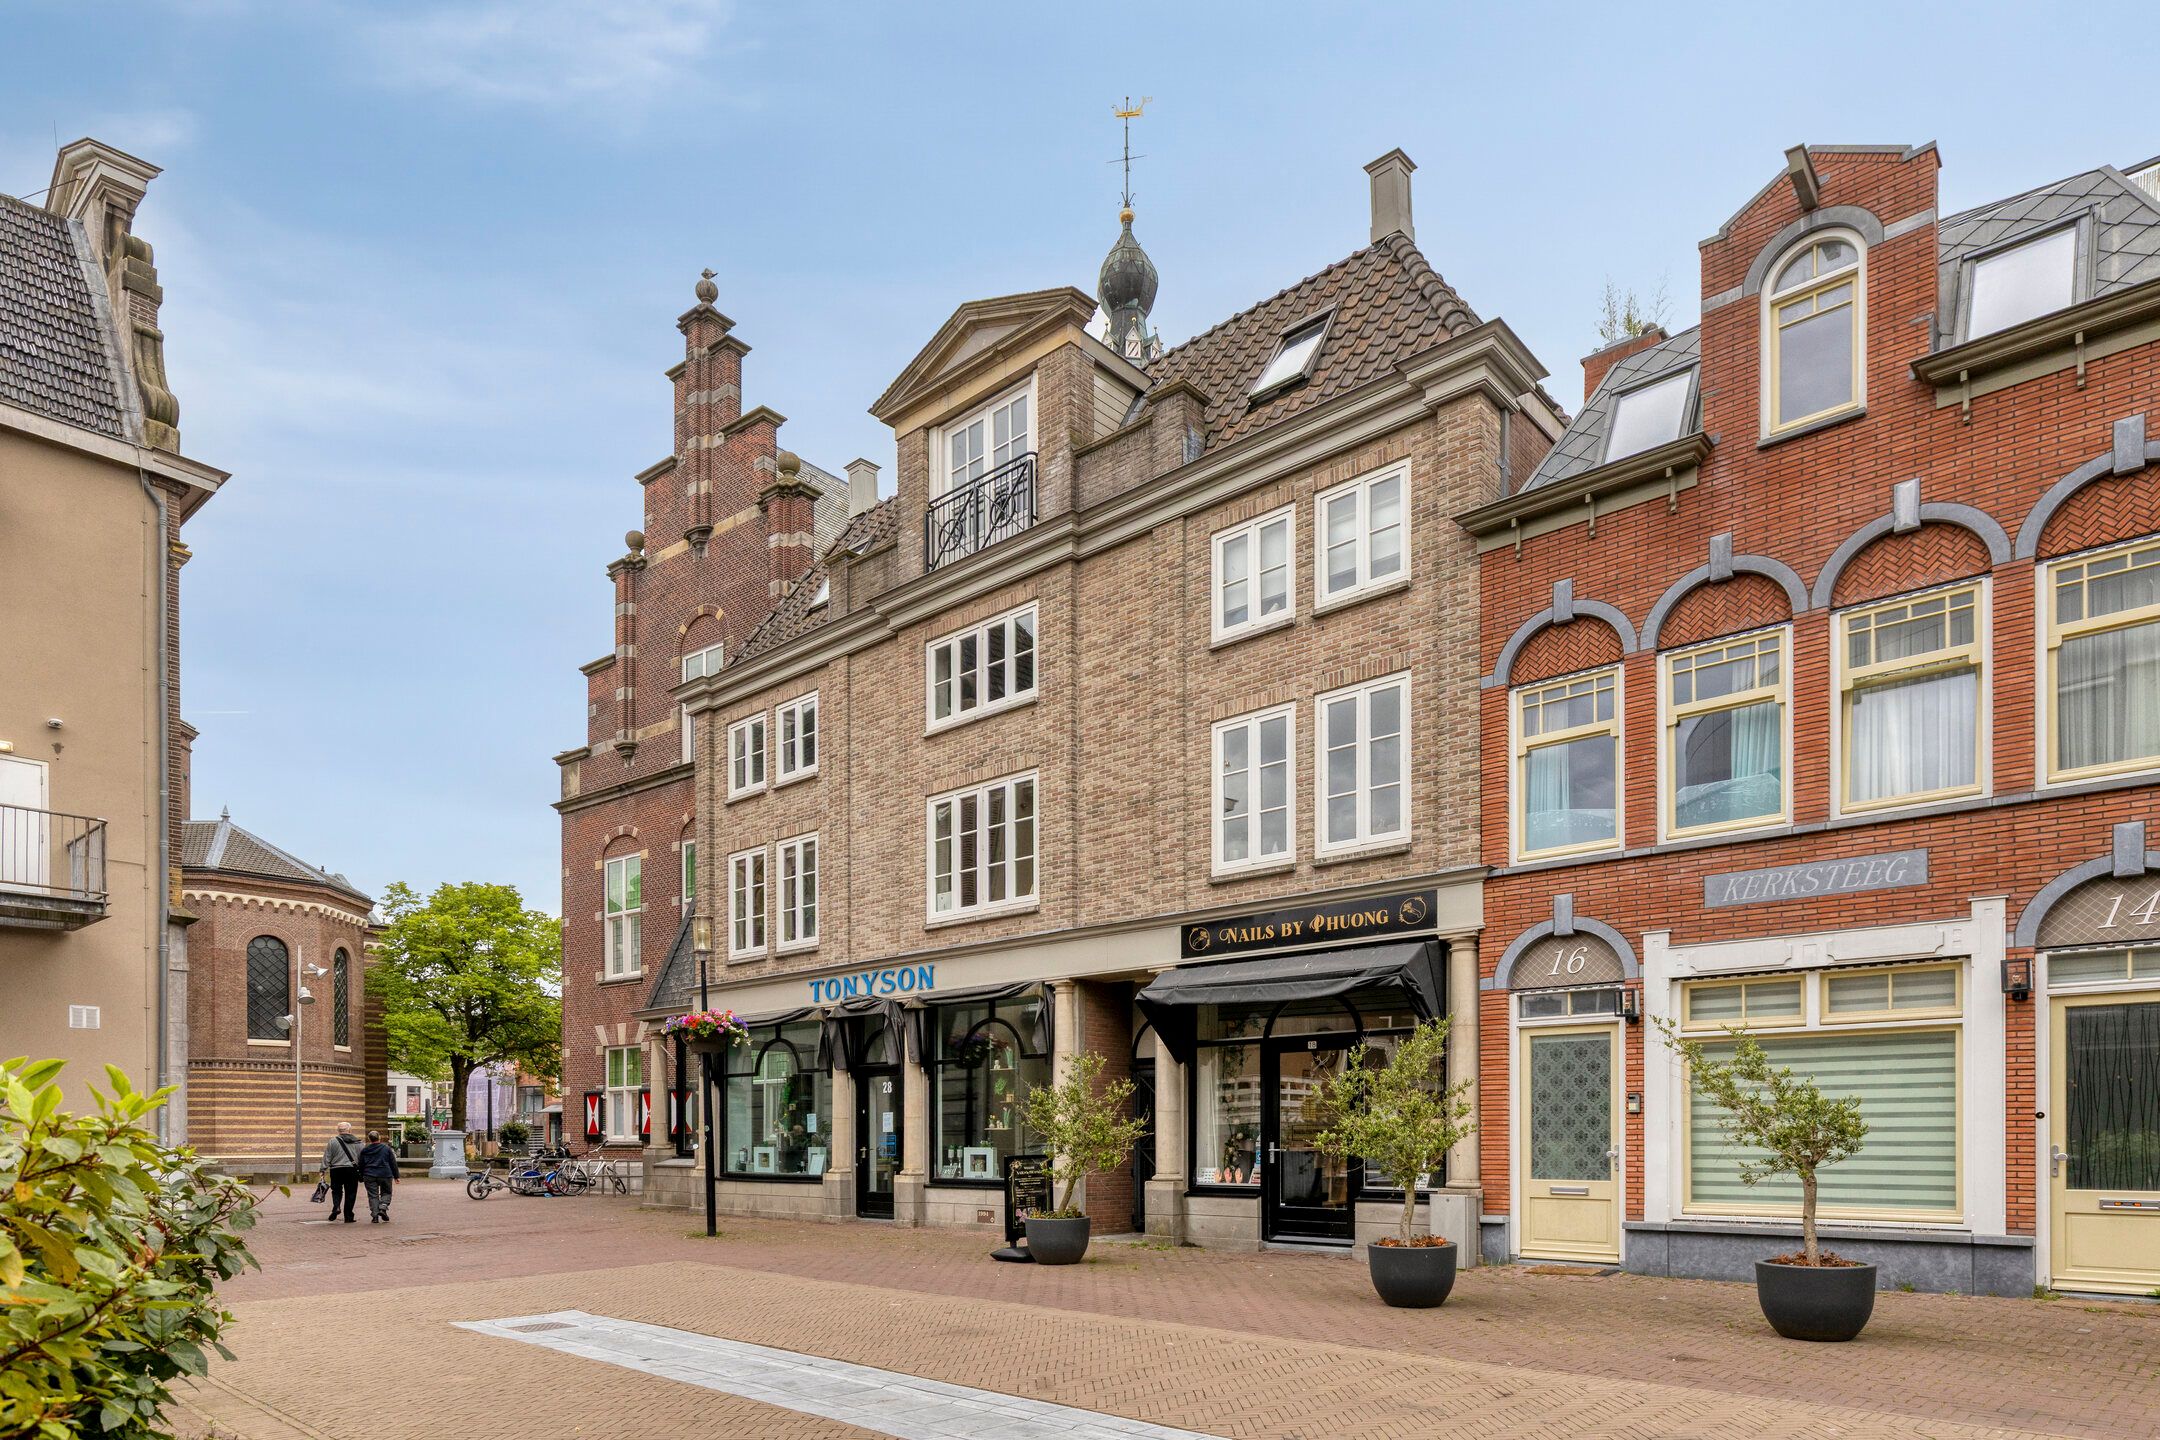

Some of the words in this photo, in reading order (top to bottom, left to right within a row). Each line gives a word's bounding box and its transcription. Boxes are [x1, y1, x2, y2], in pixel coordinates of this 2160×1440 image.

[1722, 856, 1909, 902] KERKSTEEG
[2097, 889, 2160, 929] 14
[1219, 924, 1276, 944] NAILS
[1281, 920, 1304, 937] BY
[1547, 946, 1588, 977] 16
[808, 964, 935, 1003] TONYSON
[882, 1081, 893, 1094] 28
